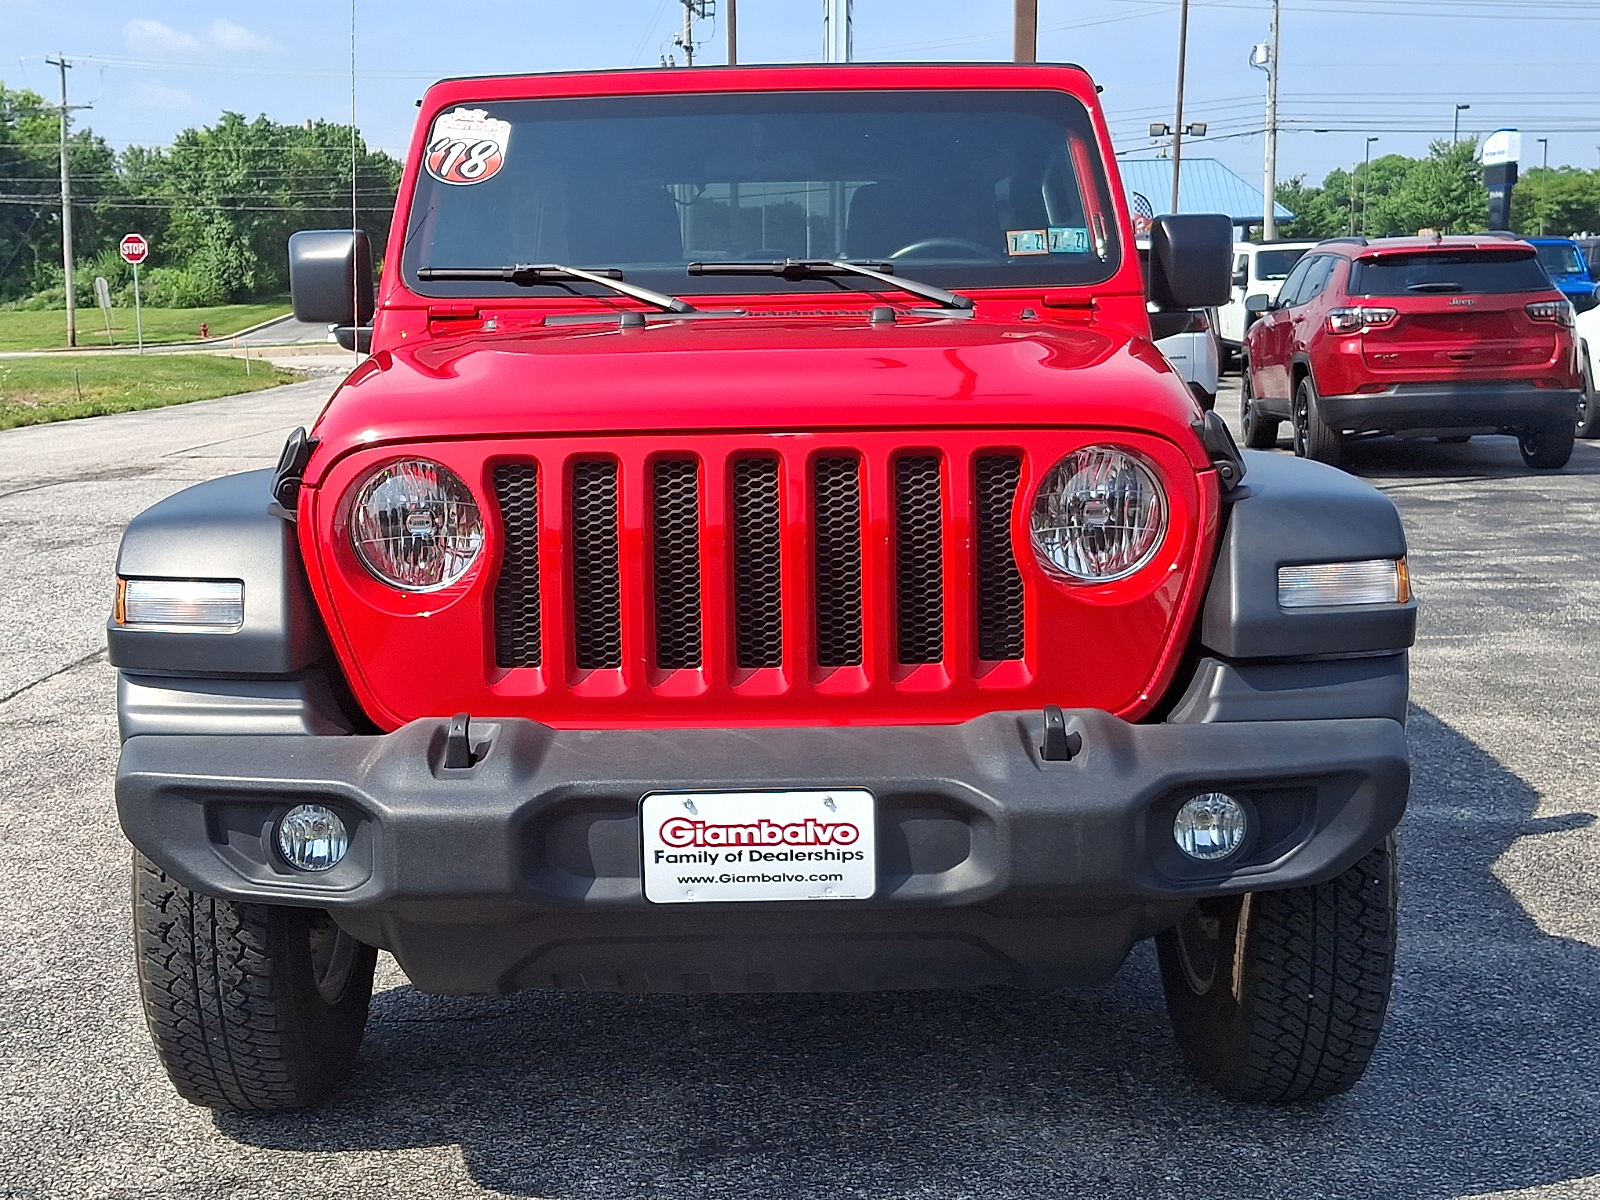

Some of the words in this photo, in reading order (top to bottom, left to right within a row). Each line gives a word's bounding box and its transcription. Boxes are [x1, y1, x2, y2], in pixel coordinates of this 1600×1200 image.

[123, 243, 145, 255] STOP
[1449, 298, 1475, 306] Jeep
[659, 817, 860, 848] Giambalvo
[654, 850, 719, 865] Family
[725, 850, 743, 863] of
[749, 848, 864, 863] Dealerships
[677, 872, 843, 884] www.Giambalvo.com
